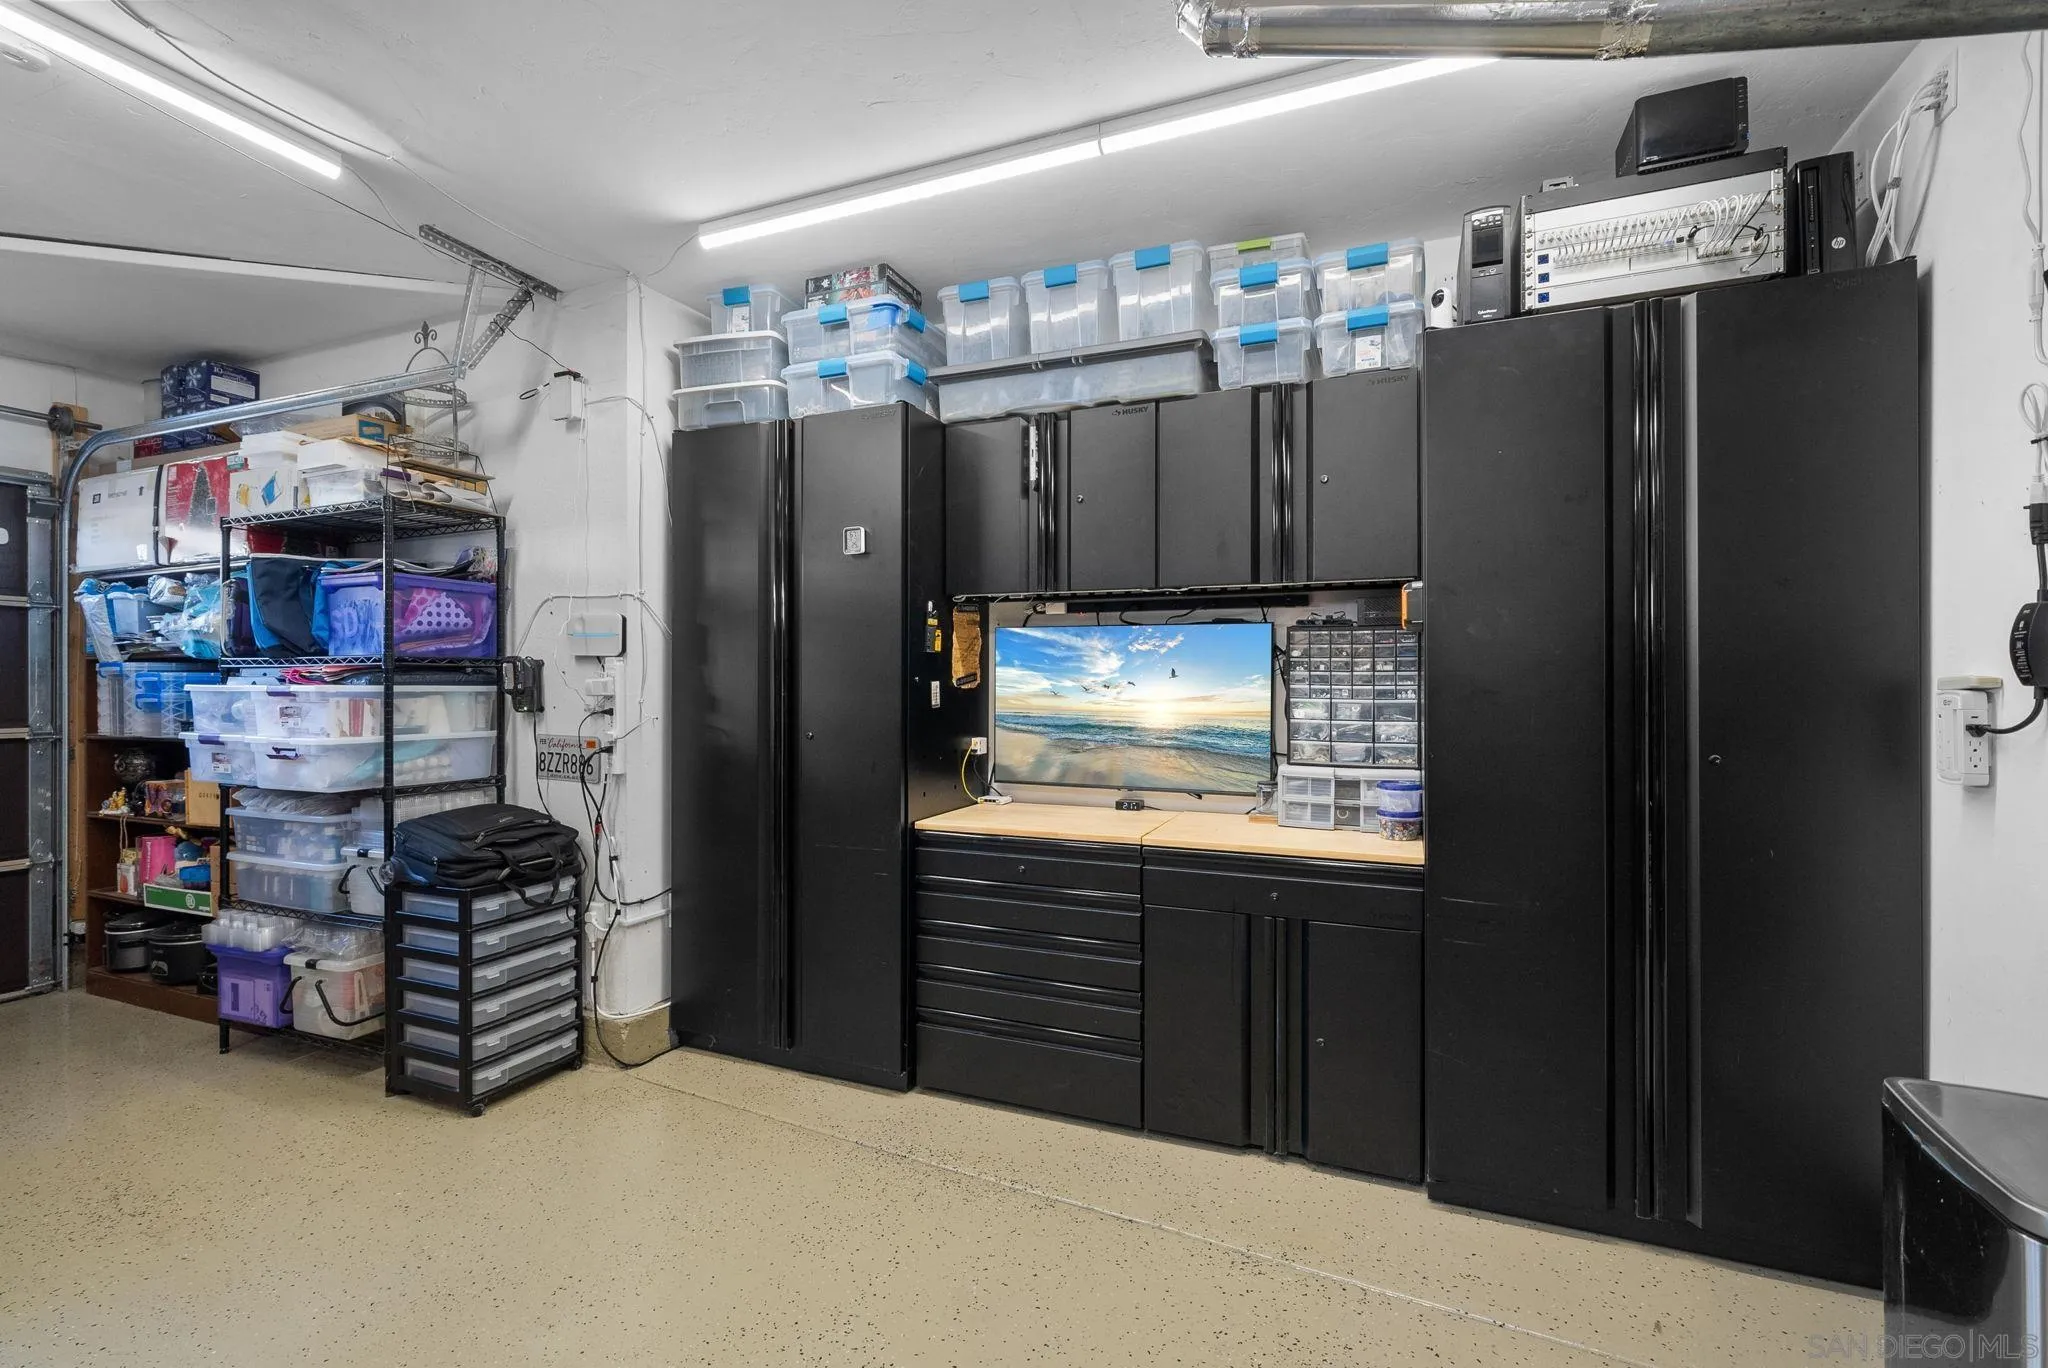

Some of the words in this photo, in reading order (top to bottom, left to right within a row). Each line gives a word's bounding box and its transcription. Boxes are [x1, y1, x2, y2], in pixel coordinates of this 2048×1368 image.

[1376, 375, 1409, 385] HUSKY
[1121, 406, 1149, 416] HUSKY
[538, 751, 594, 776] 8ZZR886
